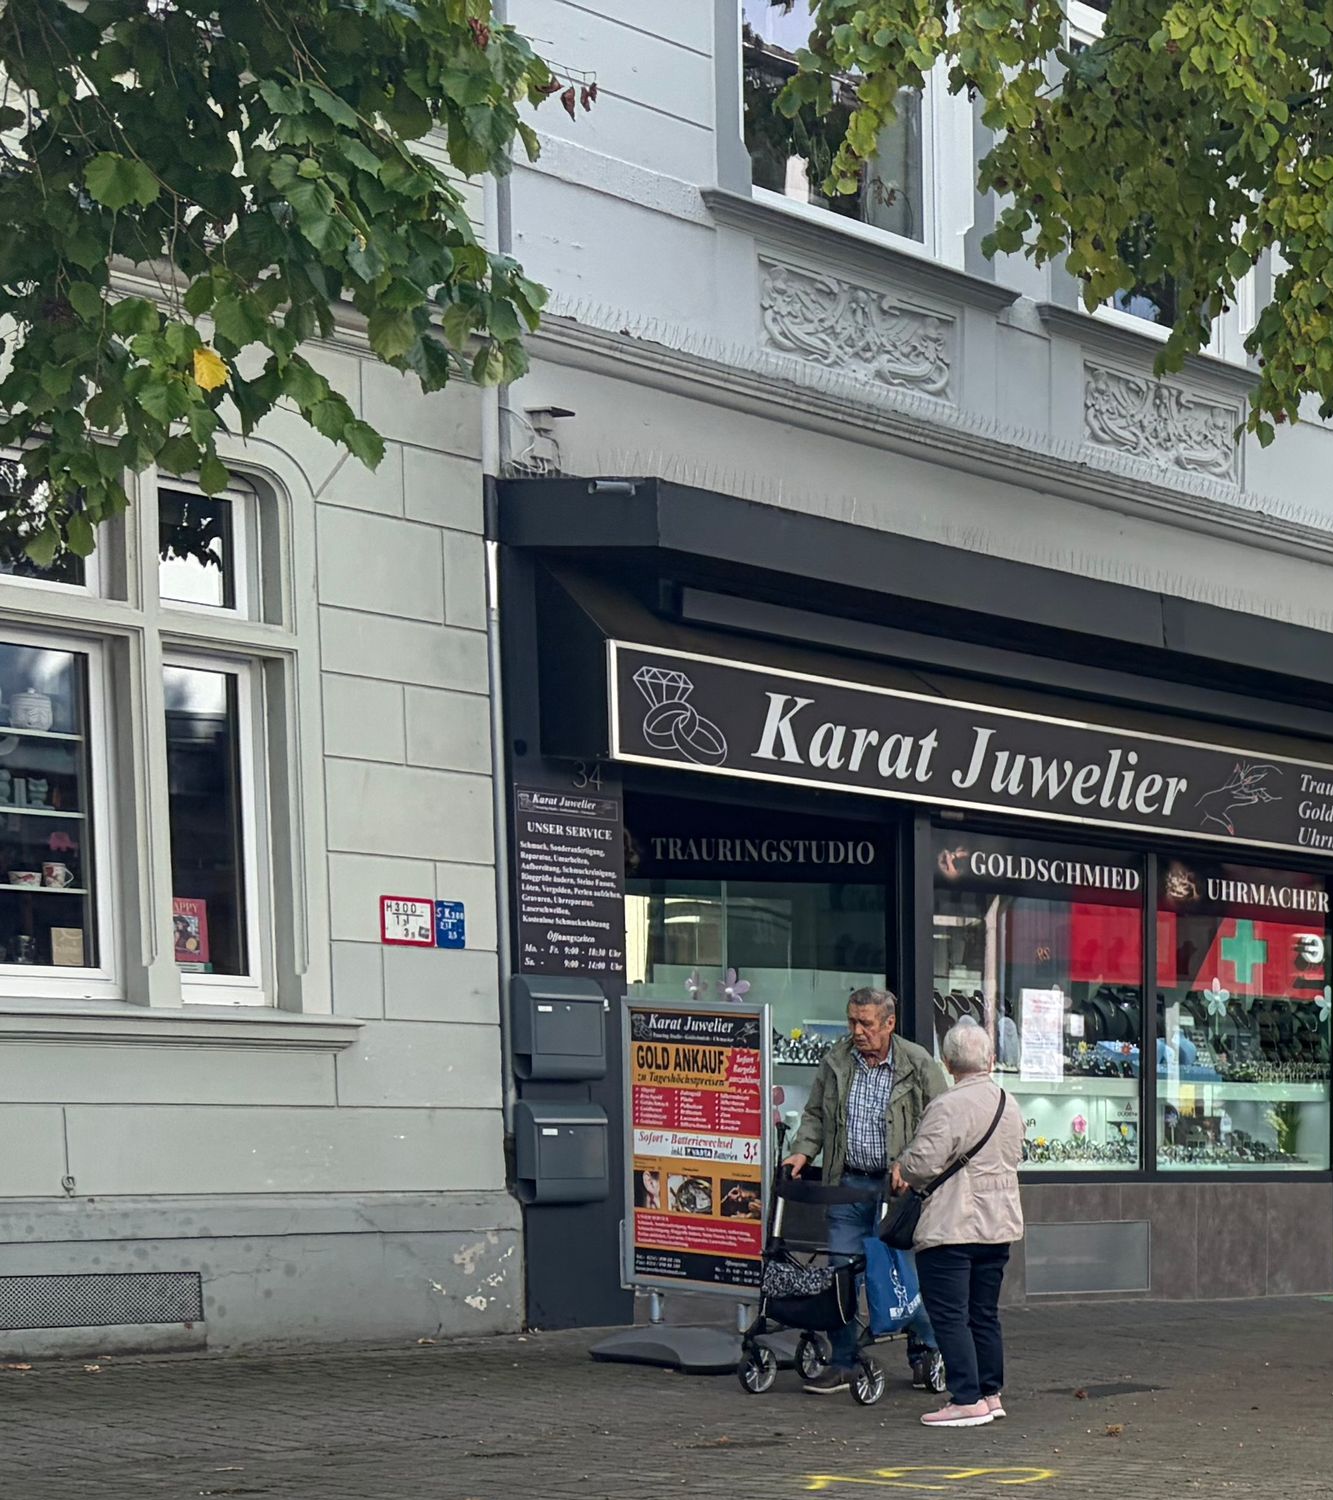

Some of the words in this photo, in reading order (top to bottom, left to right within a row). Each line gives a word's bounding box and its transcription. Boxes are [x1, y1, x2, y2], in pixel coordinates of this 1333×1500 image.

[751, 692, 938, 783] Karat
[951, 727, 1188, 816] Juwelier
[573, 760, 604, 792] 34
[532, 793, 558, 805] Karat
[527, 821, 564, 835] UNSER
[565, 825, 613, 840] SERVICE
[651, 837, 875, 865] TRAURINGSTUDIO
[970, 851, 1140, 892] GOLDSCHMIED
[1207, 878, 1330, 913] UHRMACHER
[648, 1013, 682, 1029] Karat
[683, 1016, 734, 1033] Juwelier
[636, 1045, 670, 1070] GOLD
[674, 1048, 724, 1074] ANKAUF
[638, 1132, 663, 1145] Sofort
[670, 1134, 733, 1149] Batteriewechsel
